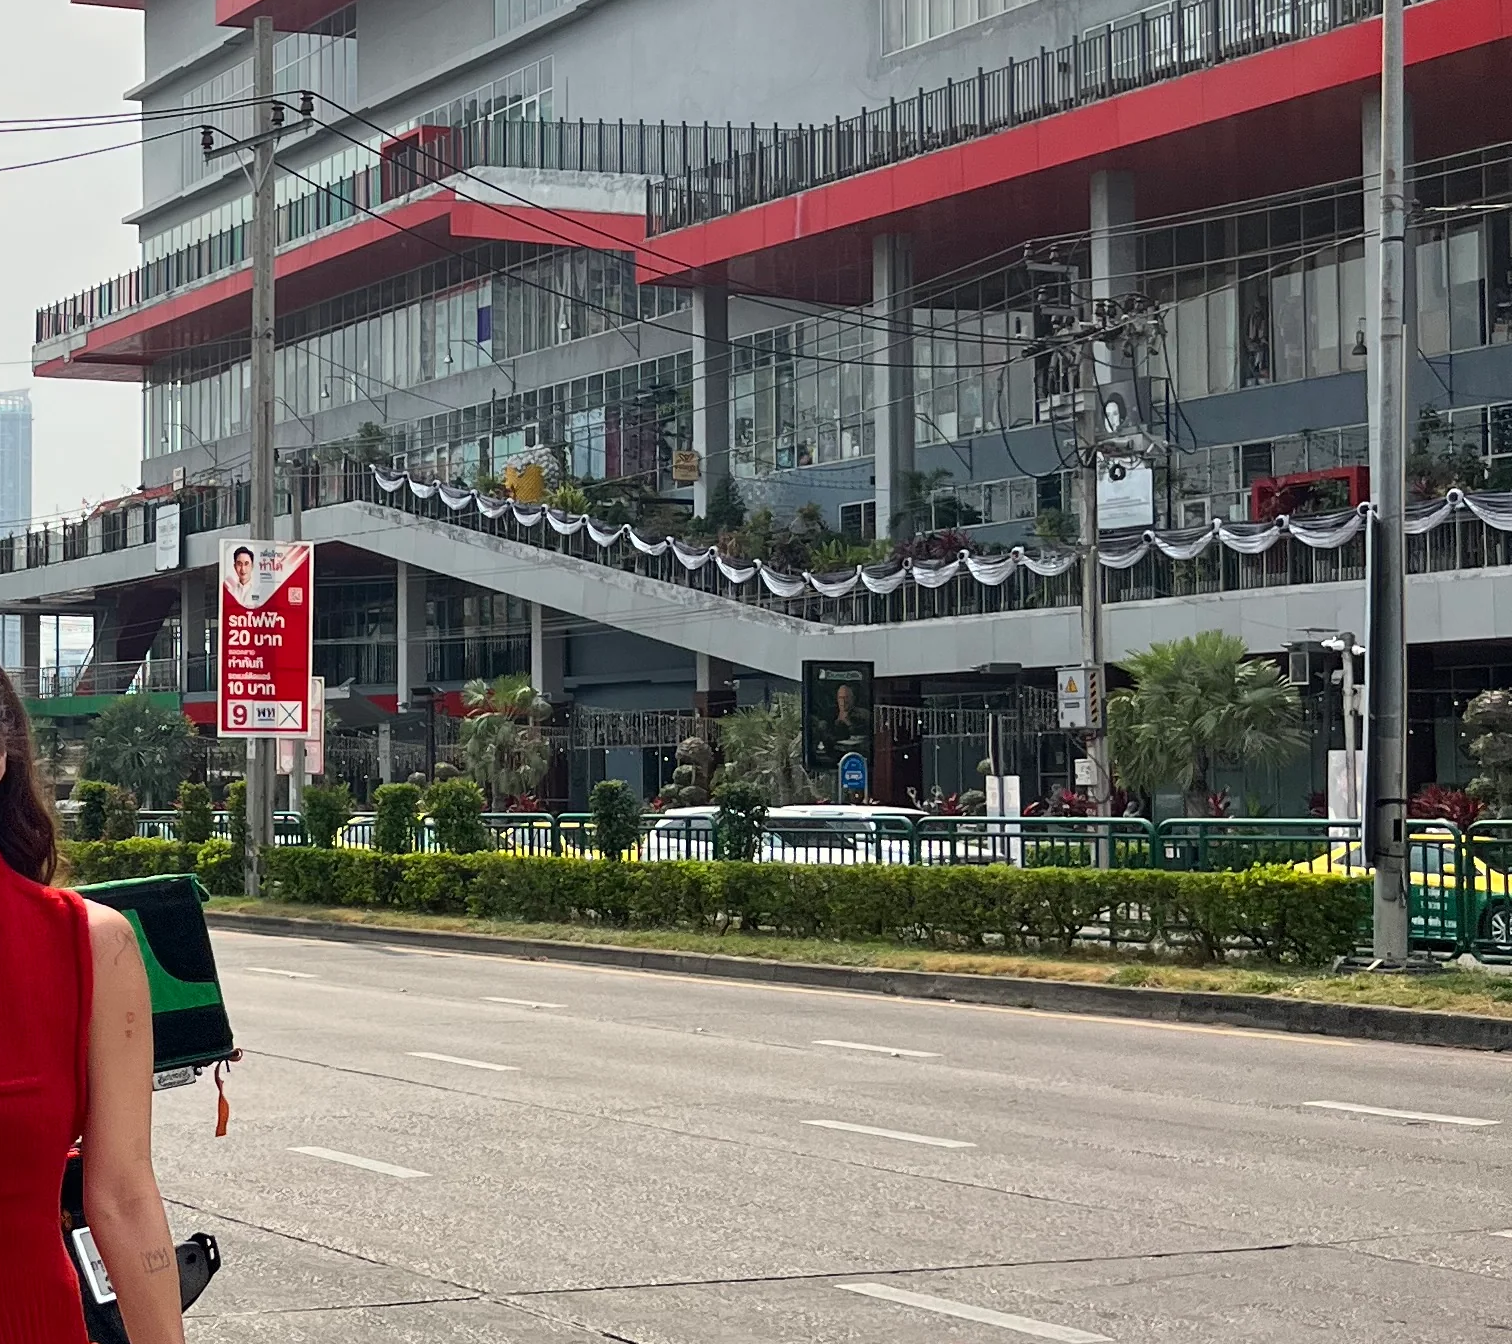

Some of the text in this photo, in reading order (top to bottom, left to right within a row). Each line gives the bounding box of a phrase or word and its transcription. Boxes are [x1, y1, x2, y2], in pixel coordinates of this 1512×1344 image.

[228, 611, 285, 629] รถไฟฟ้า
[228, 630, 283, 646] 20 บาท
[228, 681, 276, 696] 10 บาท
[232, 704, 248, 726] 9
